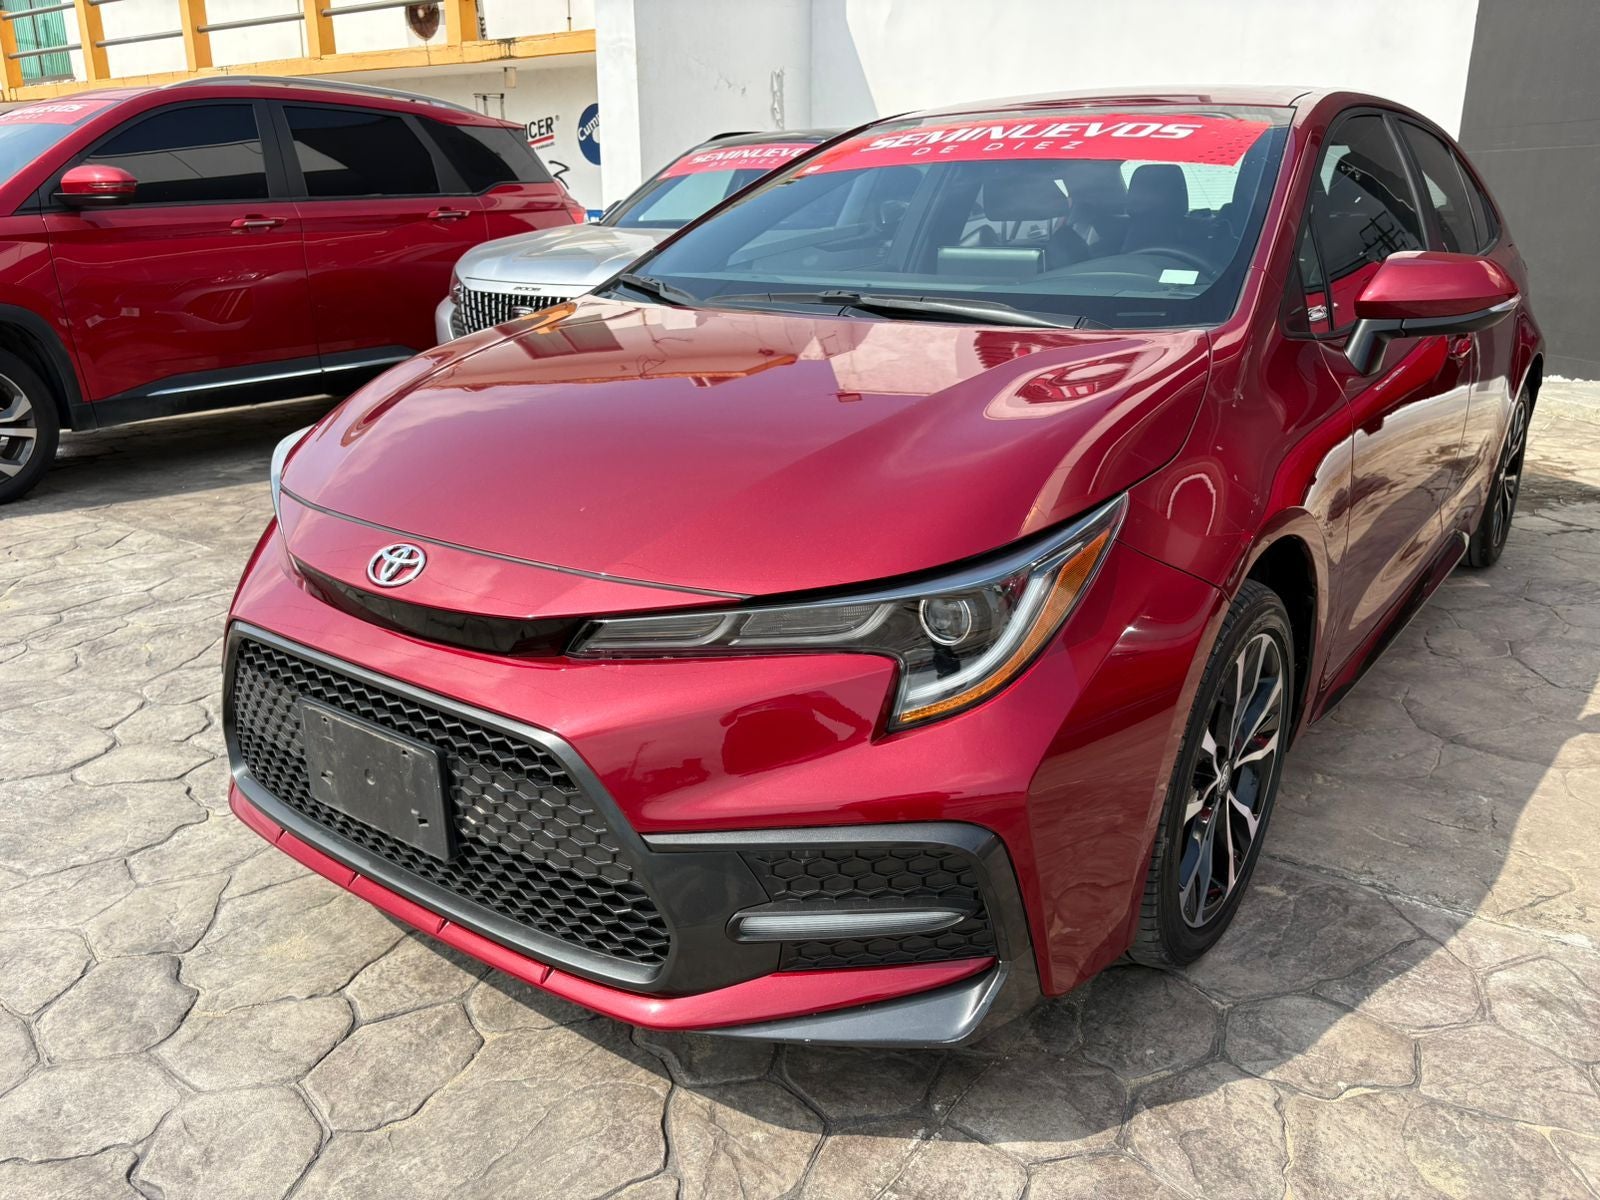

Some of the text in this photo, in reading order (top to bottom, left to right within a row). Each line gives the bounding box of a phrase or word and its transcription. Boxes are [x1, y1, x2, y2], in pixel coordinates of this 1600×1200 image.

[860, 122, 1204, 152] SEMINUEVOS
[911, 141, 1084, 156] DE DIEZ
